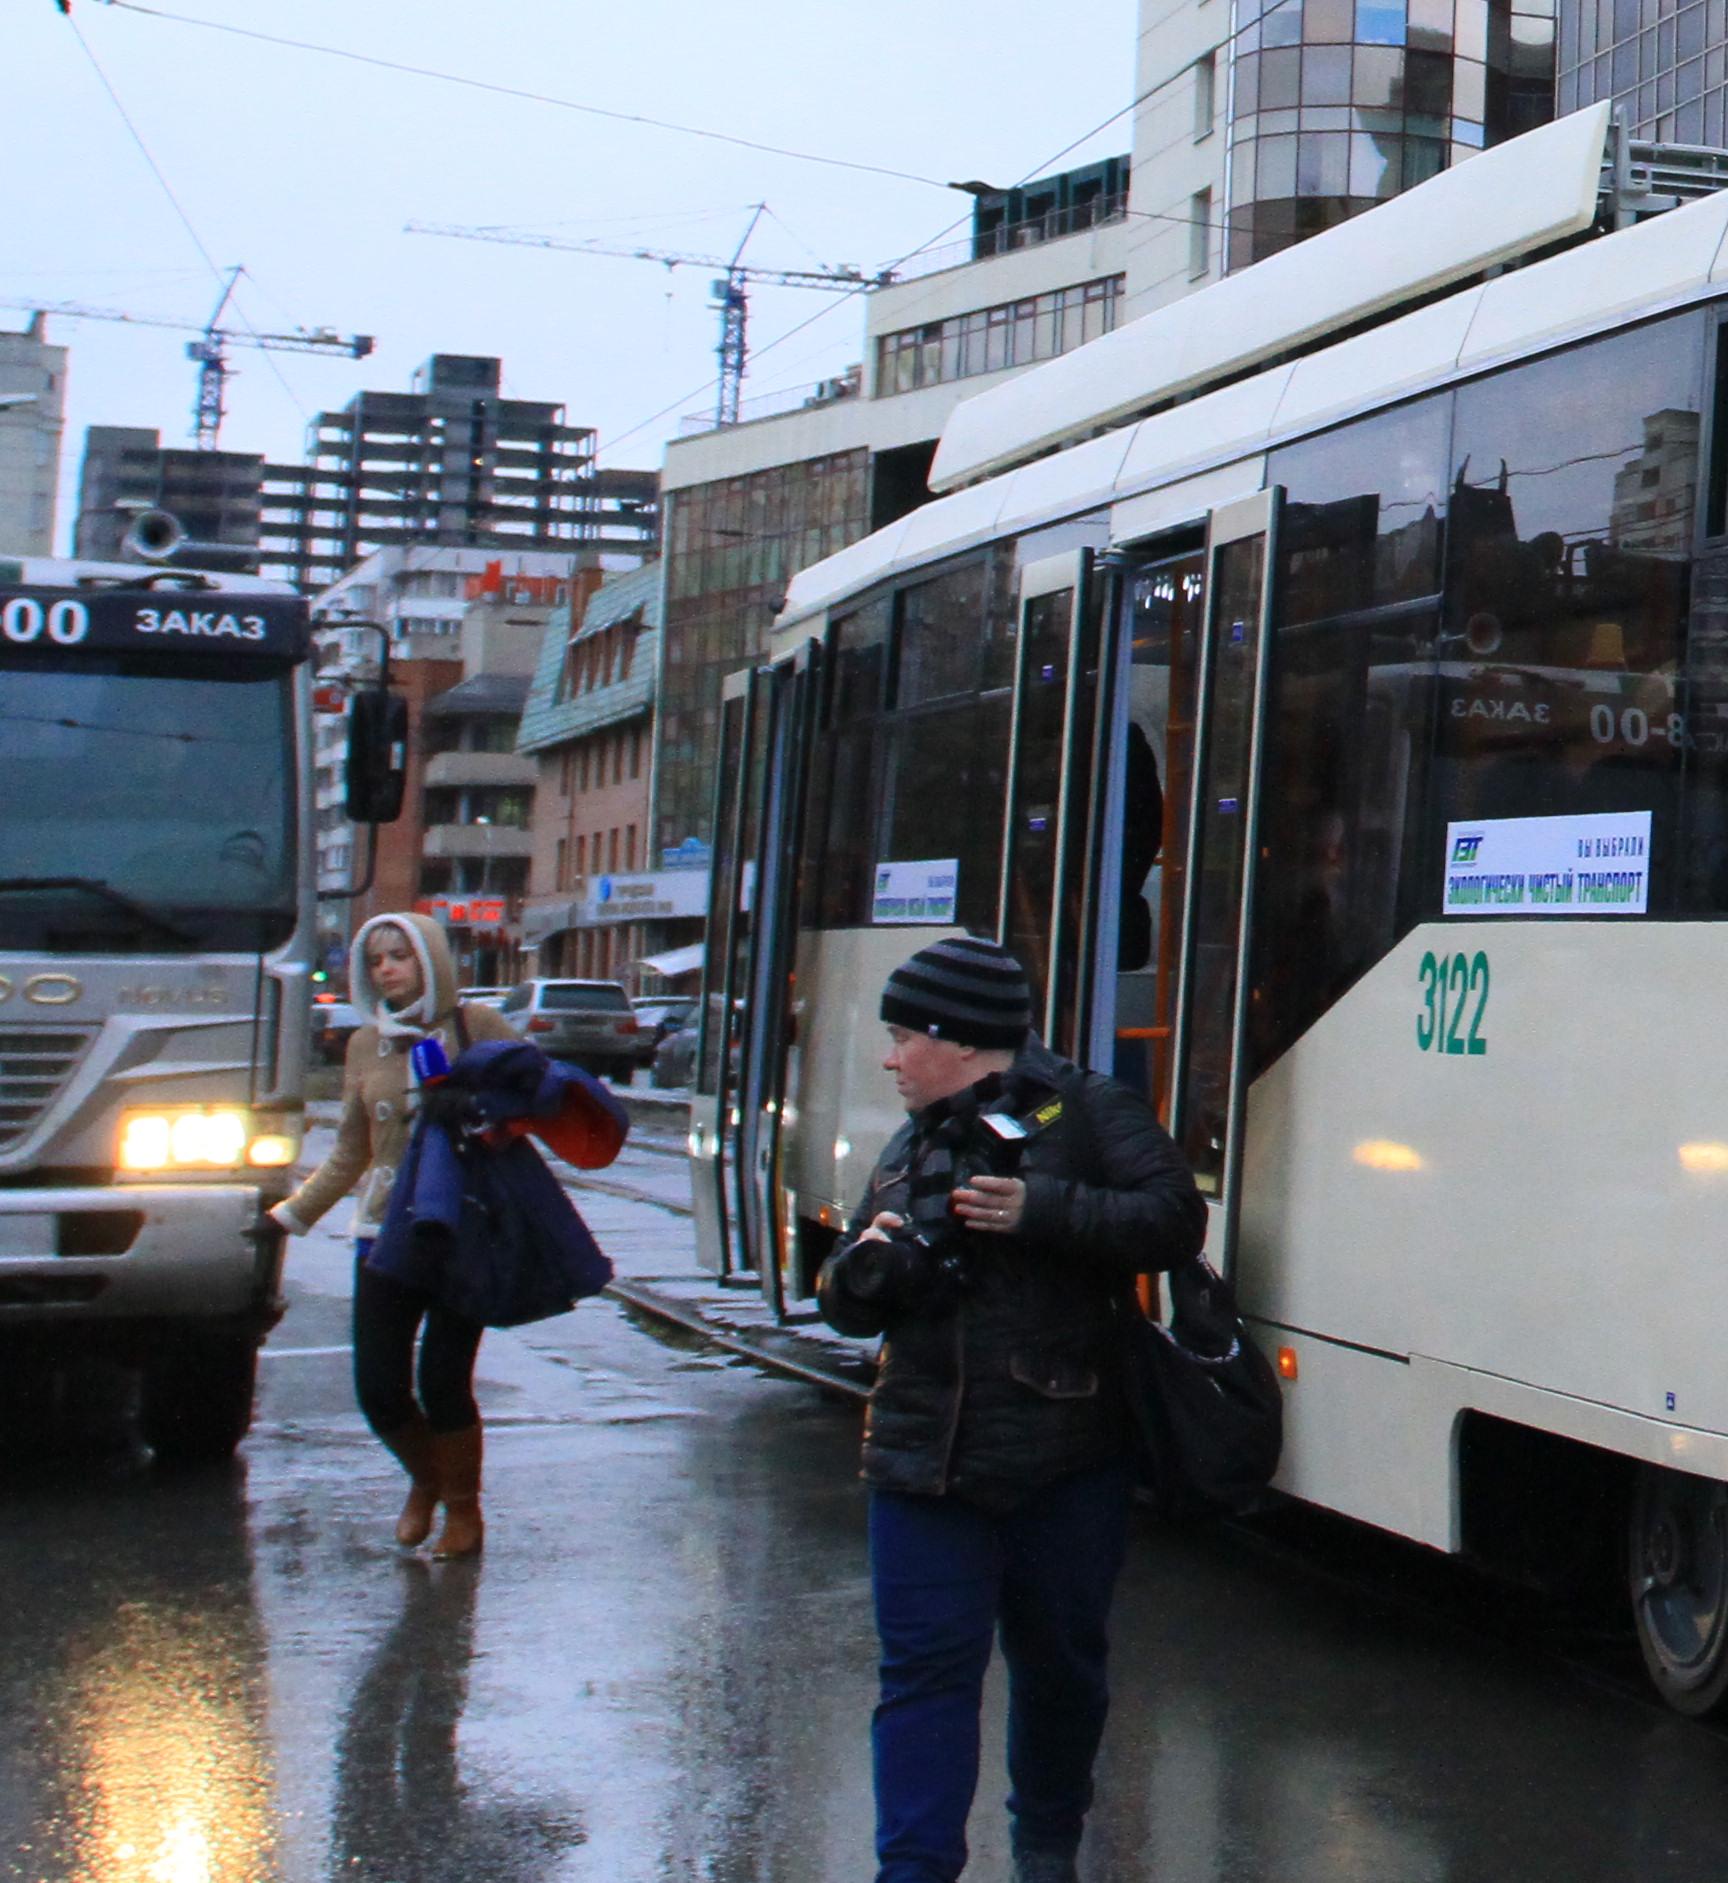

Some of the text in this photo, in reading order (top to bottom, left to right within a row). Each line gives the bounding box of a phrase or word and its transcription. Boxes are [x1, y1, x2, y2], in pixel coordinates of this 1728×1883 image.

[0, 597, 267, 645] 00 ЗАКАЗ
[1528, 868, 1574, 904] ЧИСТЫЙ
[1577, 872, 1643, 903] ТРАНСПОРТ
[1417, 949, 1489, 1055] 3122
